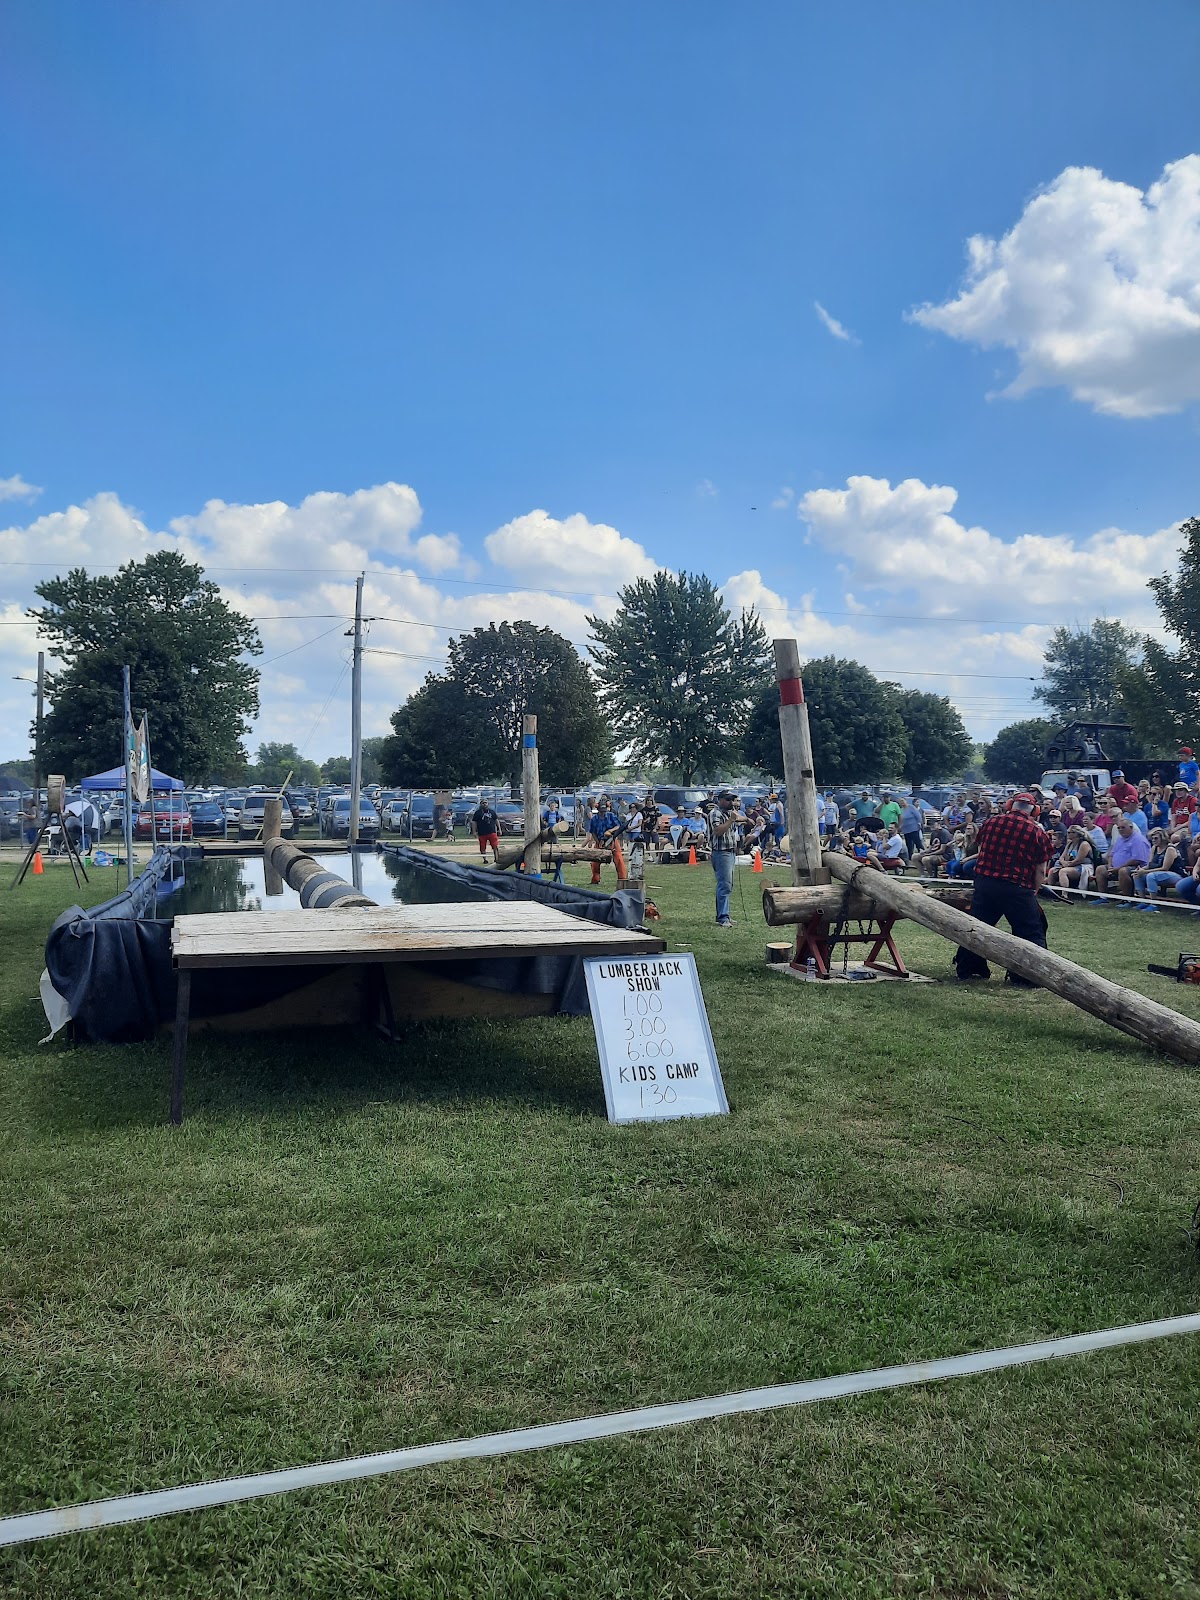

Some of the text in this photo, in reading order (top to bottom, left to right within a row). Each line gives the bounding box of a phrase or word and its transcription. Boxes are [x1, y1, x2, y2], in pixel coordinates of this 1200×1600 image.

[599, 961, 683, 979] LUMBERJACK
[628, 977, 661, 992] SHOW
[627, 1038, 674, 1062] 6:00
[619, 1062, 699, 1084] KIDS CAMP
